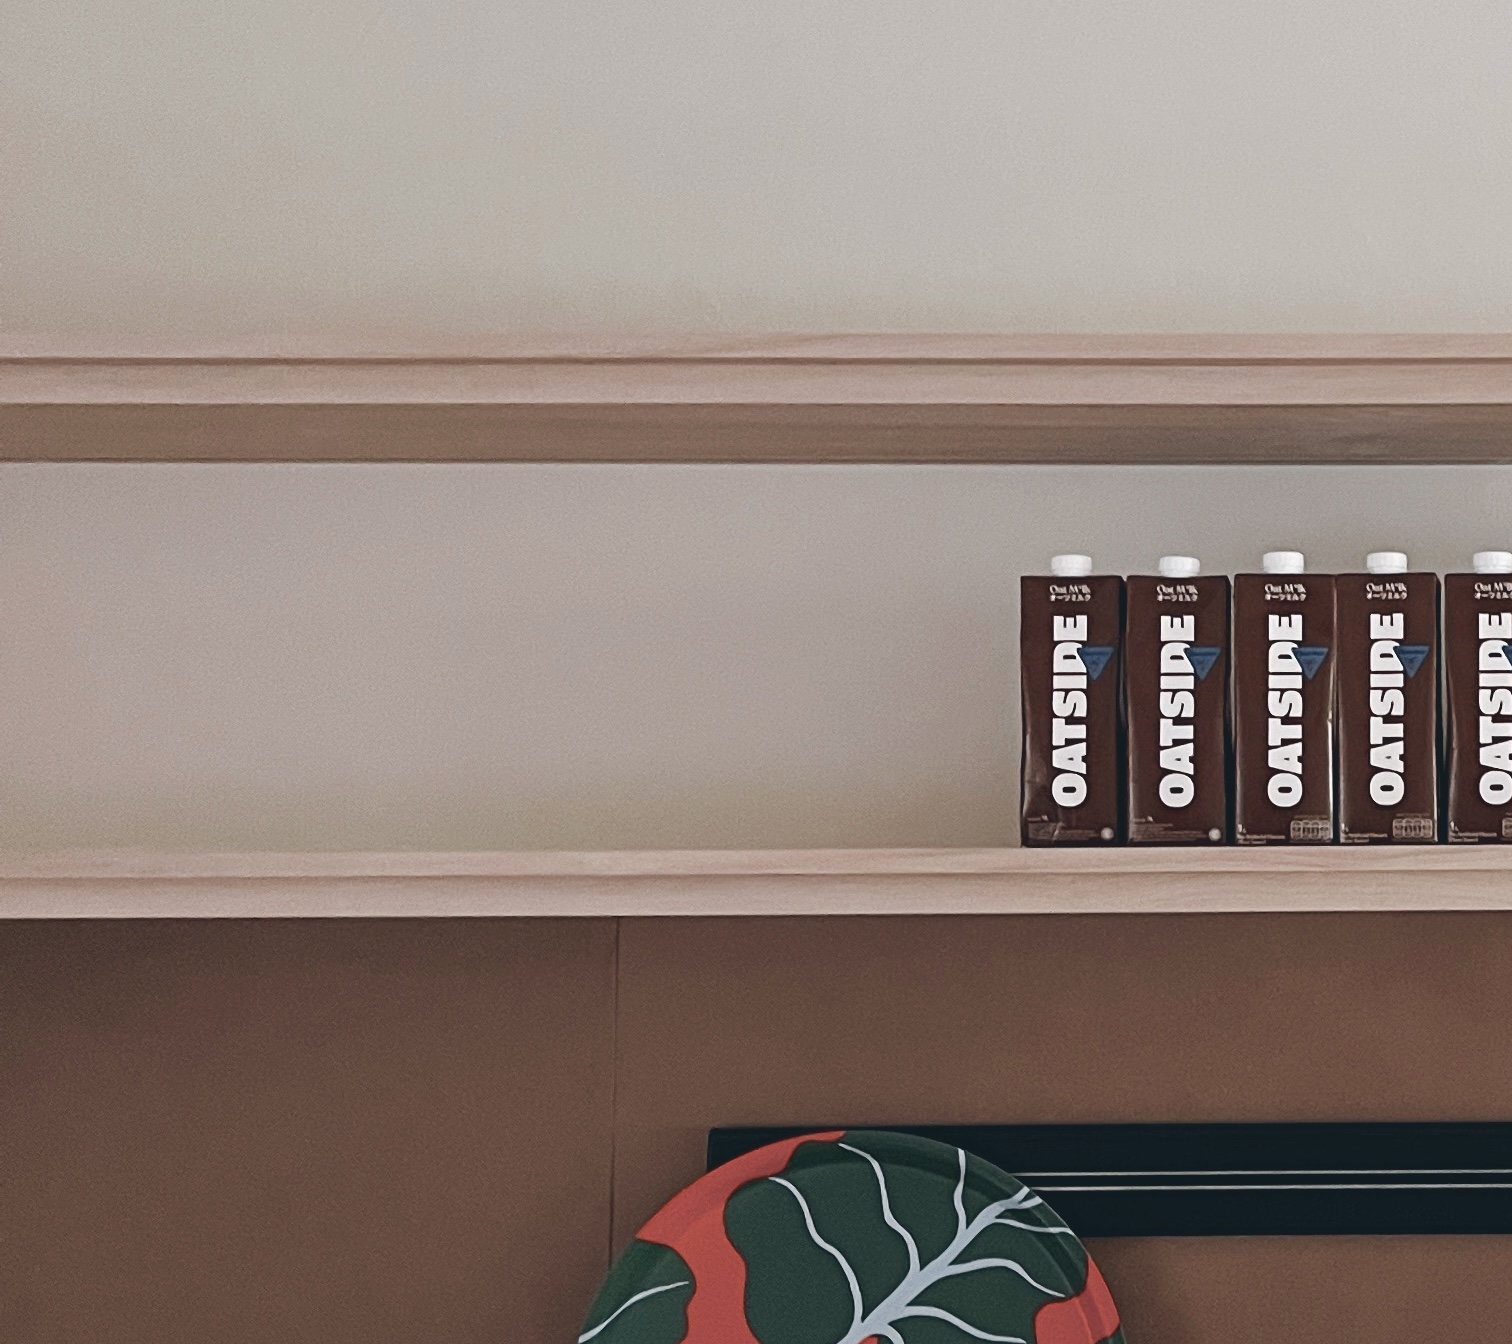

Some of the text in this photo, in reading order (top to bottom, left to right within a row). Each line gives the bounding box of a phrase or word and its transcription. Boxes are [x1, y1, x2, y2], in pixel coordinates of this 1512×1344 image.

[1052, 615, 1087, 807] OATSIDE
[1159, 615, 1194, 807] OATSIDE
[1267, 614, 1303, 807] OATSIDE
[1369, 613, 1405, 805] OATSIDE
